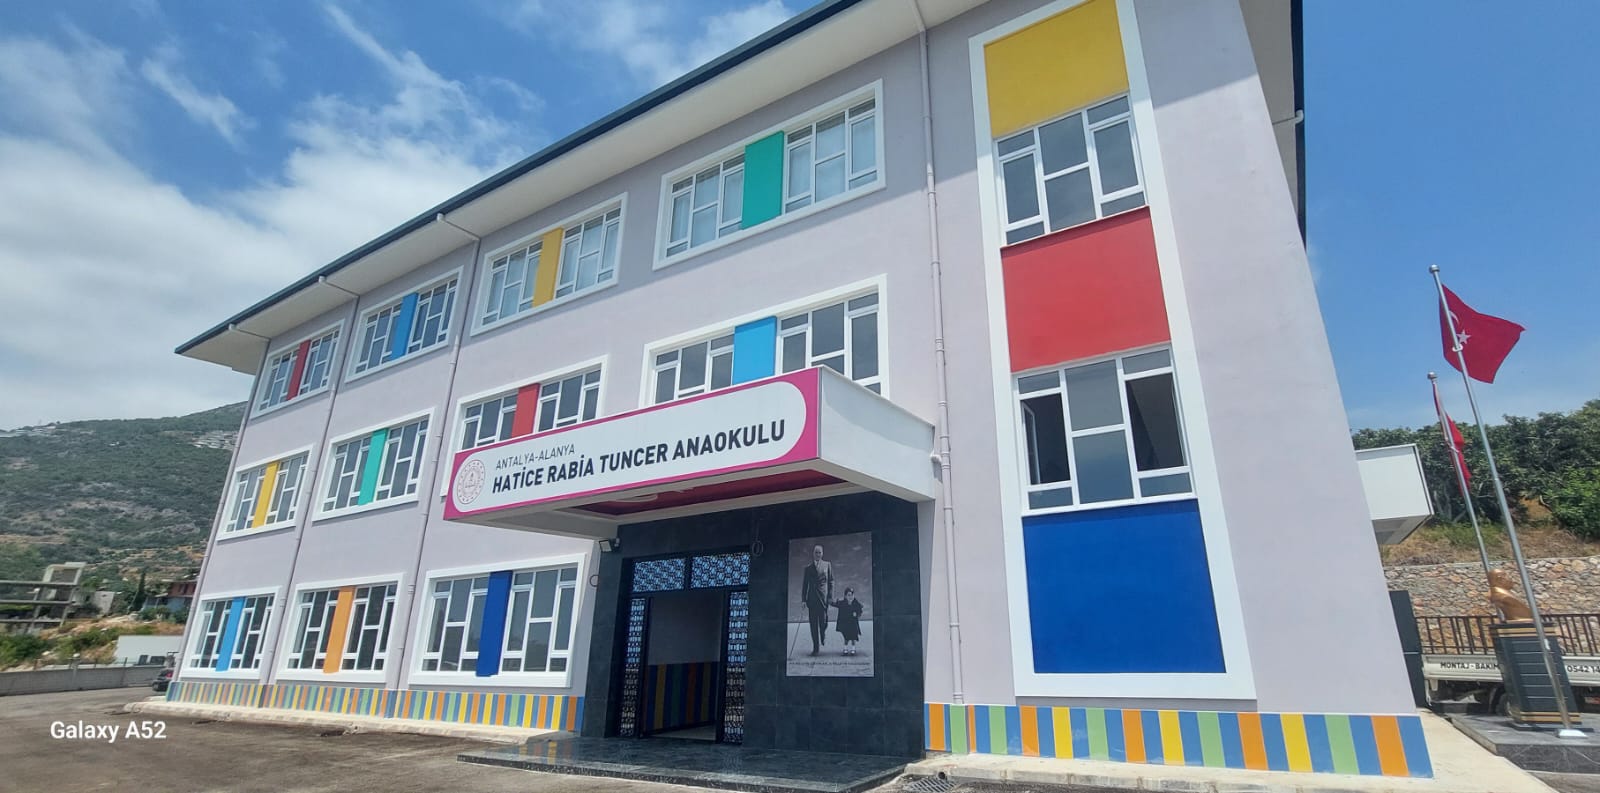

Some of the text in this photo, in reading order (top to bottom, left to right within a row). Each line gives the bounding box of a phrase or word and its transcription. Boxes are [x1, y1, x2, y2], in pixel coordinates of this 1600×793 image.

[491, 466, 544, 494] HATİCE
[546, 454, 595, 484] RABİA
[599, 443, 668, 475] TUNCER
[673, 419, 785, 459] ANAOKULU
[495, 442, 576, 470] ANTALYA-ALANYA
